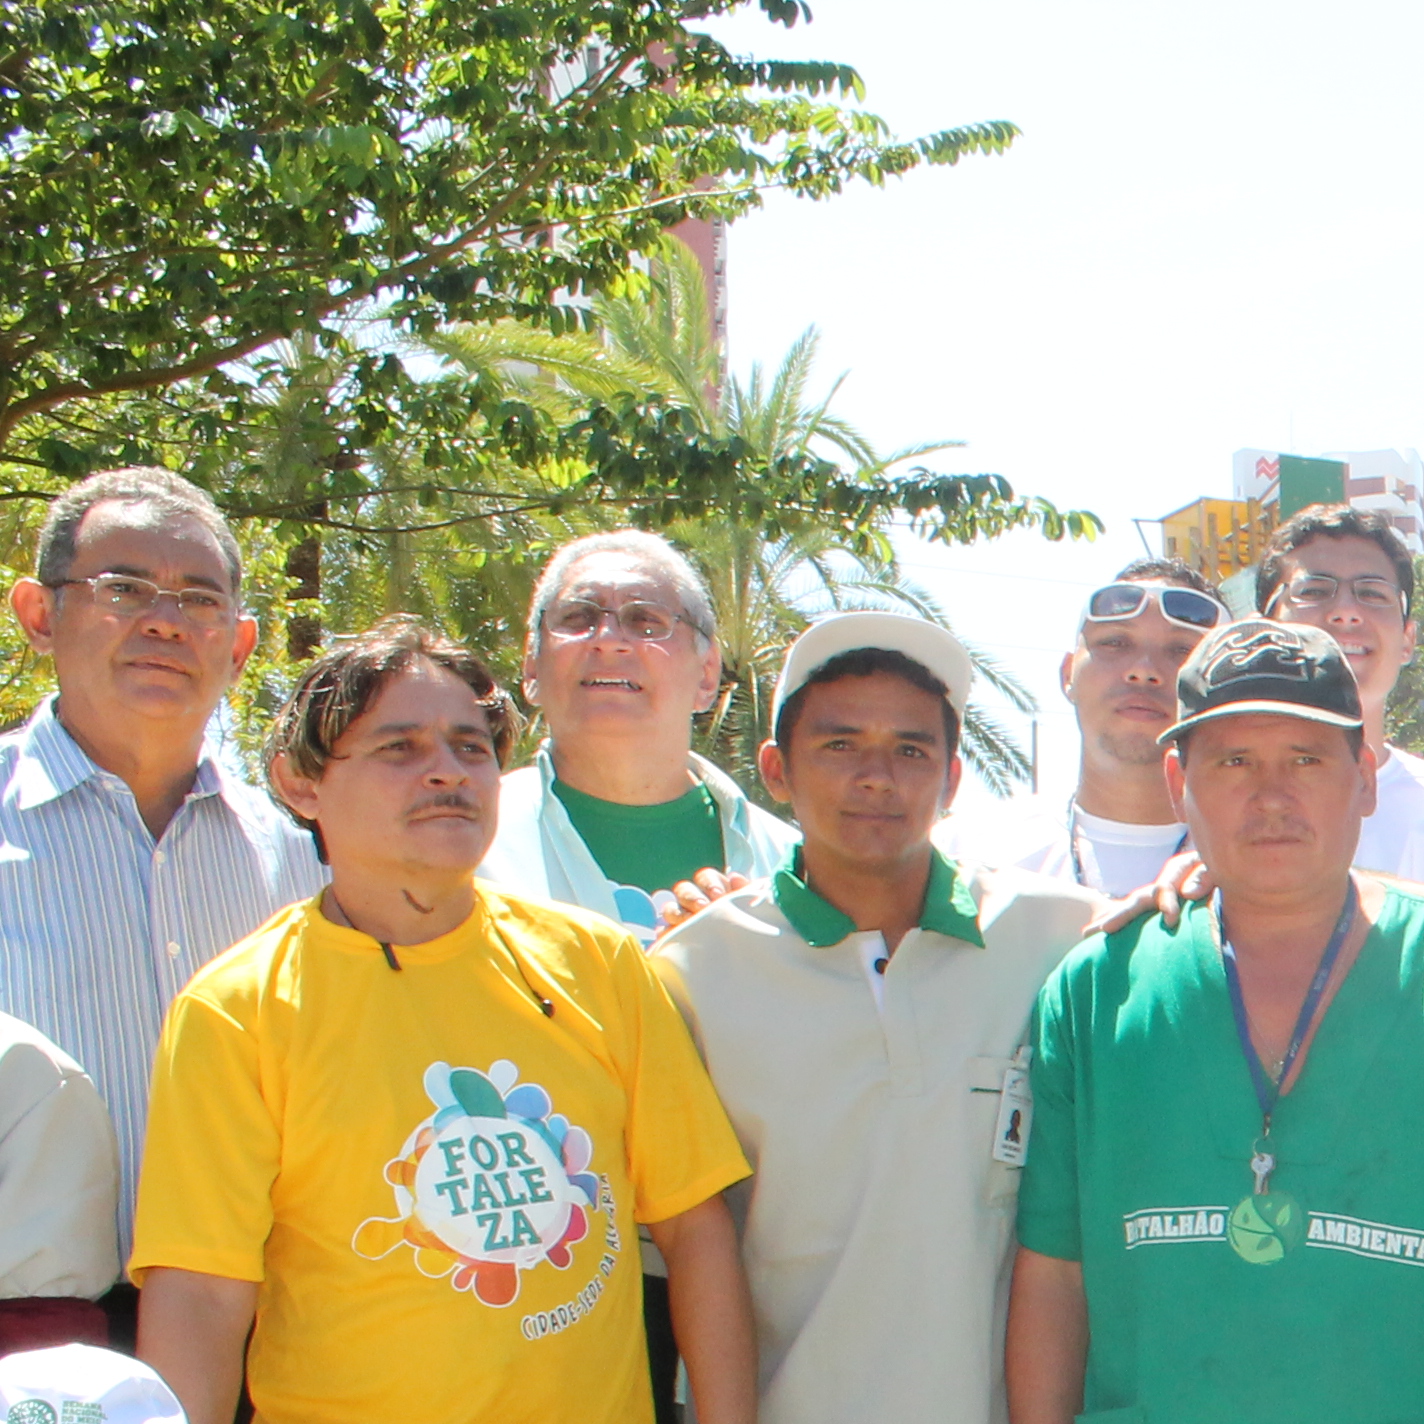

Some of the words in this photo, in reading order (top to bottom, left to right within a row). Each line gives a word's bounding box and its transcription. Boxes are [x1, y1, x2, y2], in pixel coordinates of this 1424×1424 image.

[438, 1131, 535, 1176] FOR
[435, 1168, 554, 1217] TALE
[478, 1214, 542, 1253] ZA
[600, 1252, 616, 1277] DA
